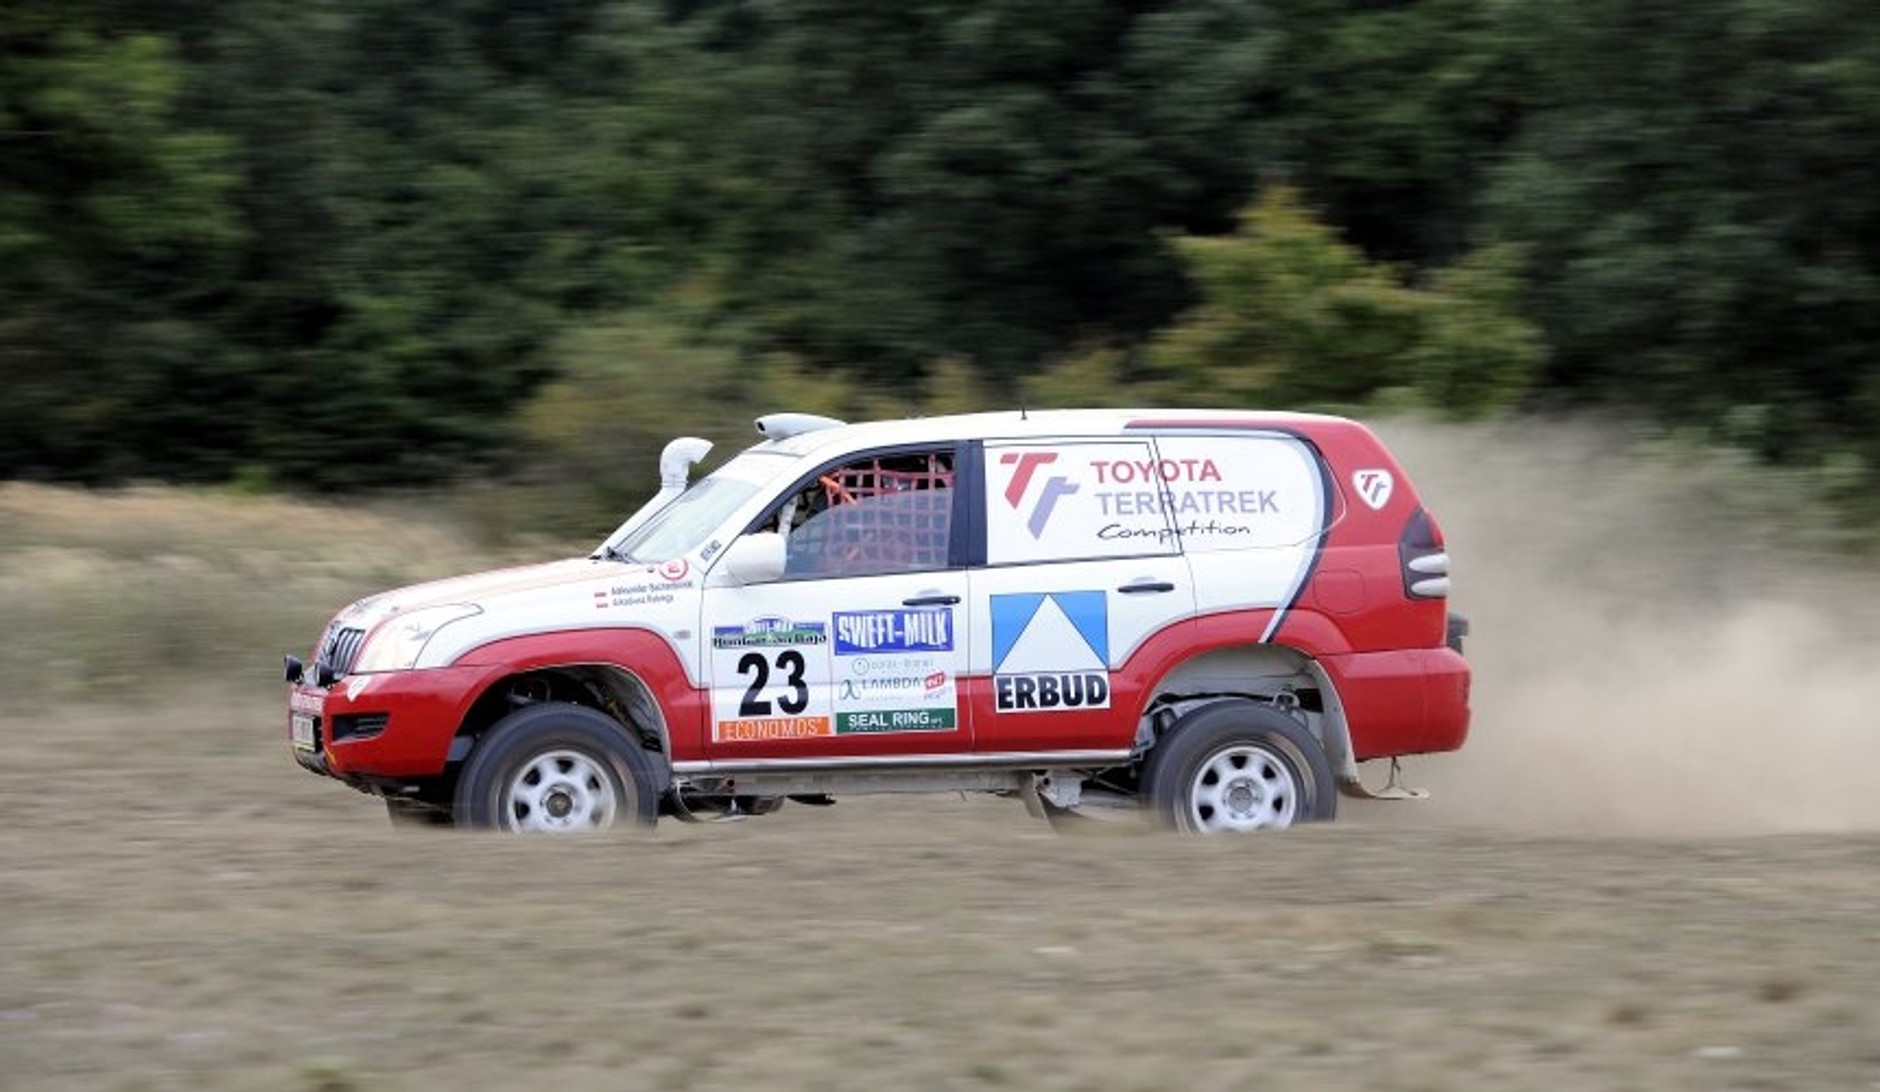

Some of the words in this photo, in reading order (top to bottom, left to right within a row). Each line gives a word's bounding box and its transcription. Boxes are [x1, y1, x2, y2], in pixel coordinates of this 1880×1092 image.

[1090, 459, 1222, 484] TOYOTA
[1094, 490, 1280, 515] TERRATREK
[1097, 519, 1251, 545] Competition
[737, 649, 809, 717] 23
[862, 676, 920, 689] LAMBDA
[996, 674, 1108, 709] ERBUD
[848, 714, 888, 727] SEAL
[893, 712, 930, 726] RING
